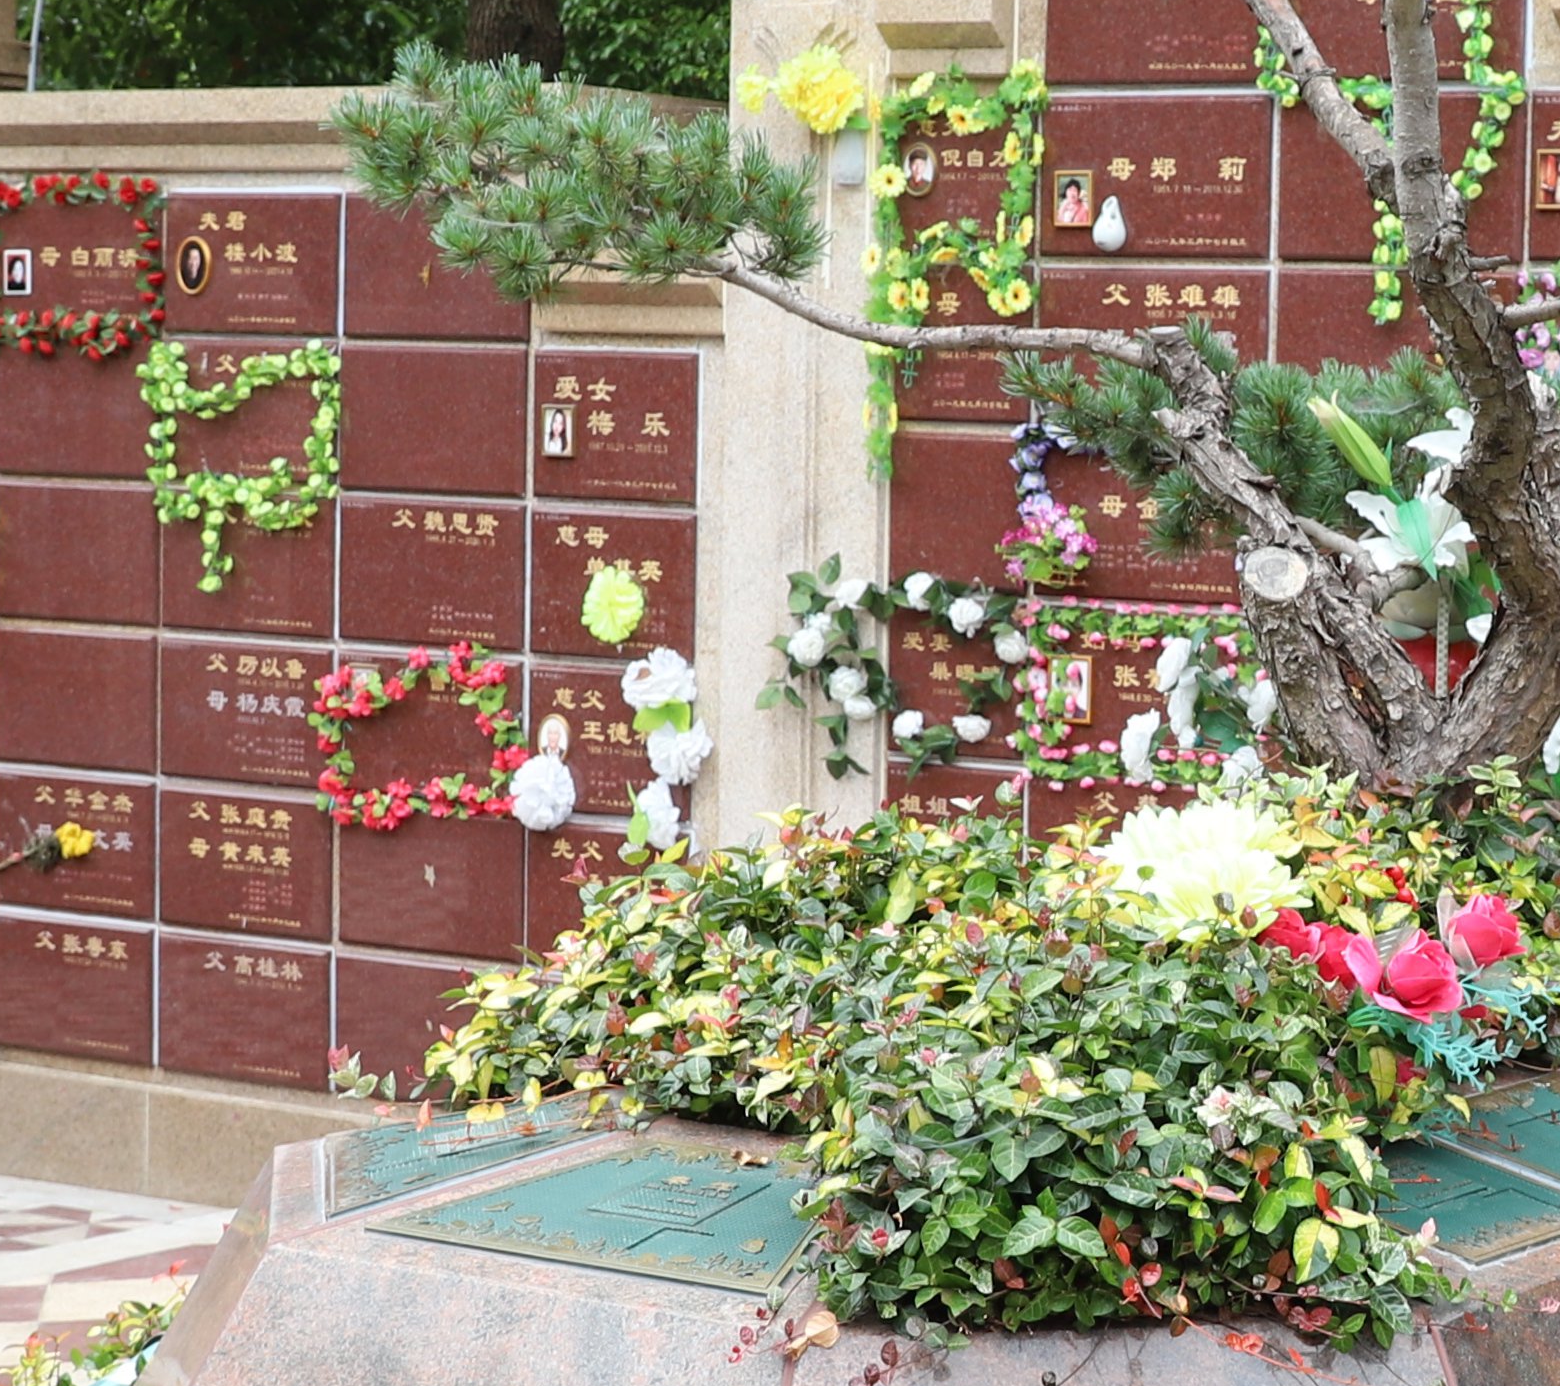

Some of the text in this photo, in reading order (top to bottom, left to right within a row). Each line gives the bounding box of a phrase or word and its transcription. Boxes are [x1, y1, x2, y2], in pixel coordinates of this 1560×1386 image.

[1106, 156, 1136, 183] 母
[39, 246, 61, 267] 母
[1101, 282, 1132, 308] 父
[552, 375, 618, 403] 爱女
[391, 508, 417, 531] 父
[1097, 494, 1128, 520] 母
